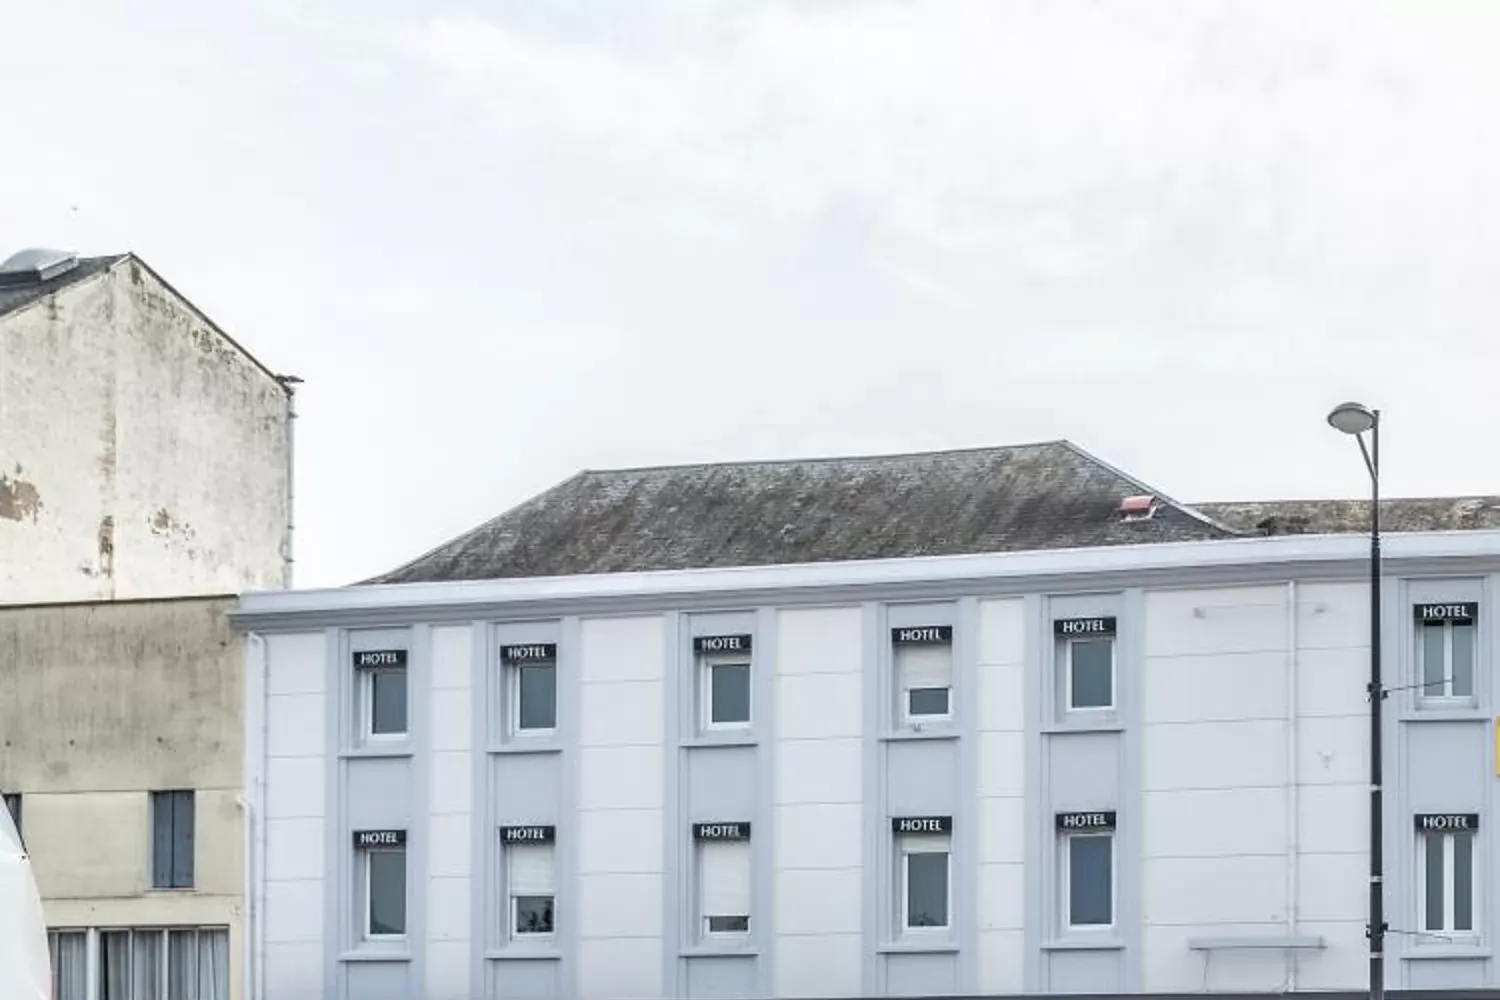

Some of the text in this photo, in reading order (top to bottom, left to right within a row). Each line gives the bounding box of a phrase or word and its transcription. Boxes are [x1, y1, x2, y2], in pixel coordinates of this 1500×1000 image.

[1423, 605, 1469, 618] HOTEL
[1063, 619, 1105, 633] HOTEL
[900, 629, 942, 641] HOTEL
[702, 636, 742, 650] HOTEL
[361, 652, 398, 665] HOTEL
[508, 646, 547, 659] HOTEL
[900, 819, 942, 831] HOTEL
[1064, 814, 1107, 827] HOTEL
[1423, 816, 1468, 829] HOTEL
[507, 827, 545, 840] HOTEL
[701, 825, 742, 837] HOTEL
[361, 832, 398, 844] HOTEL
